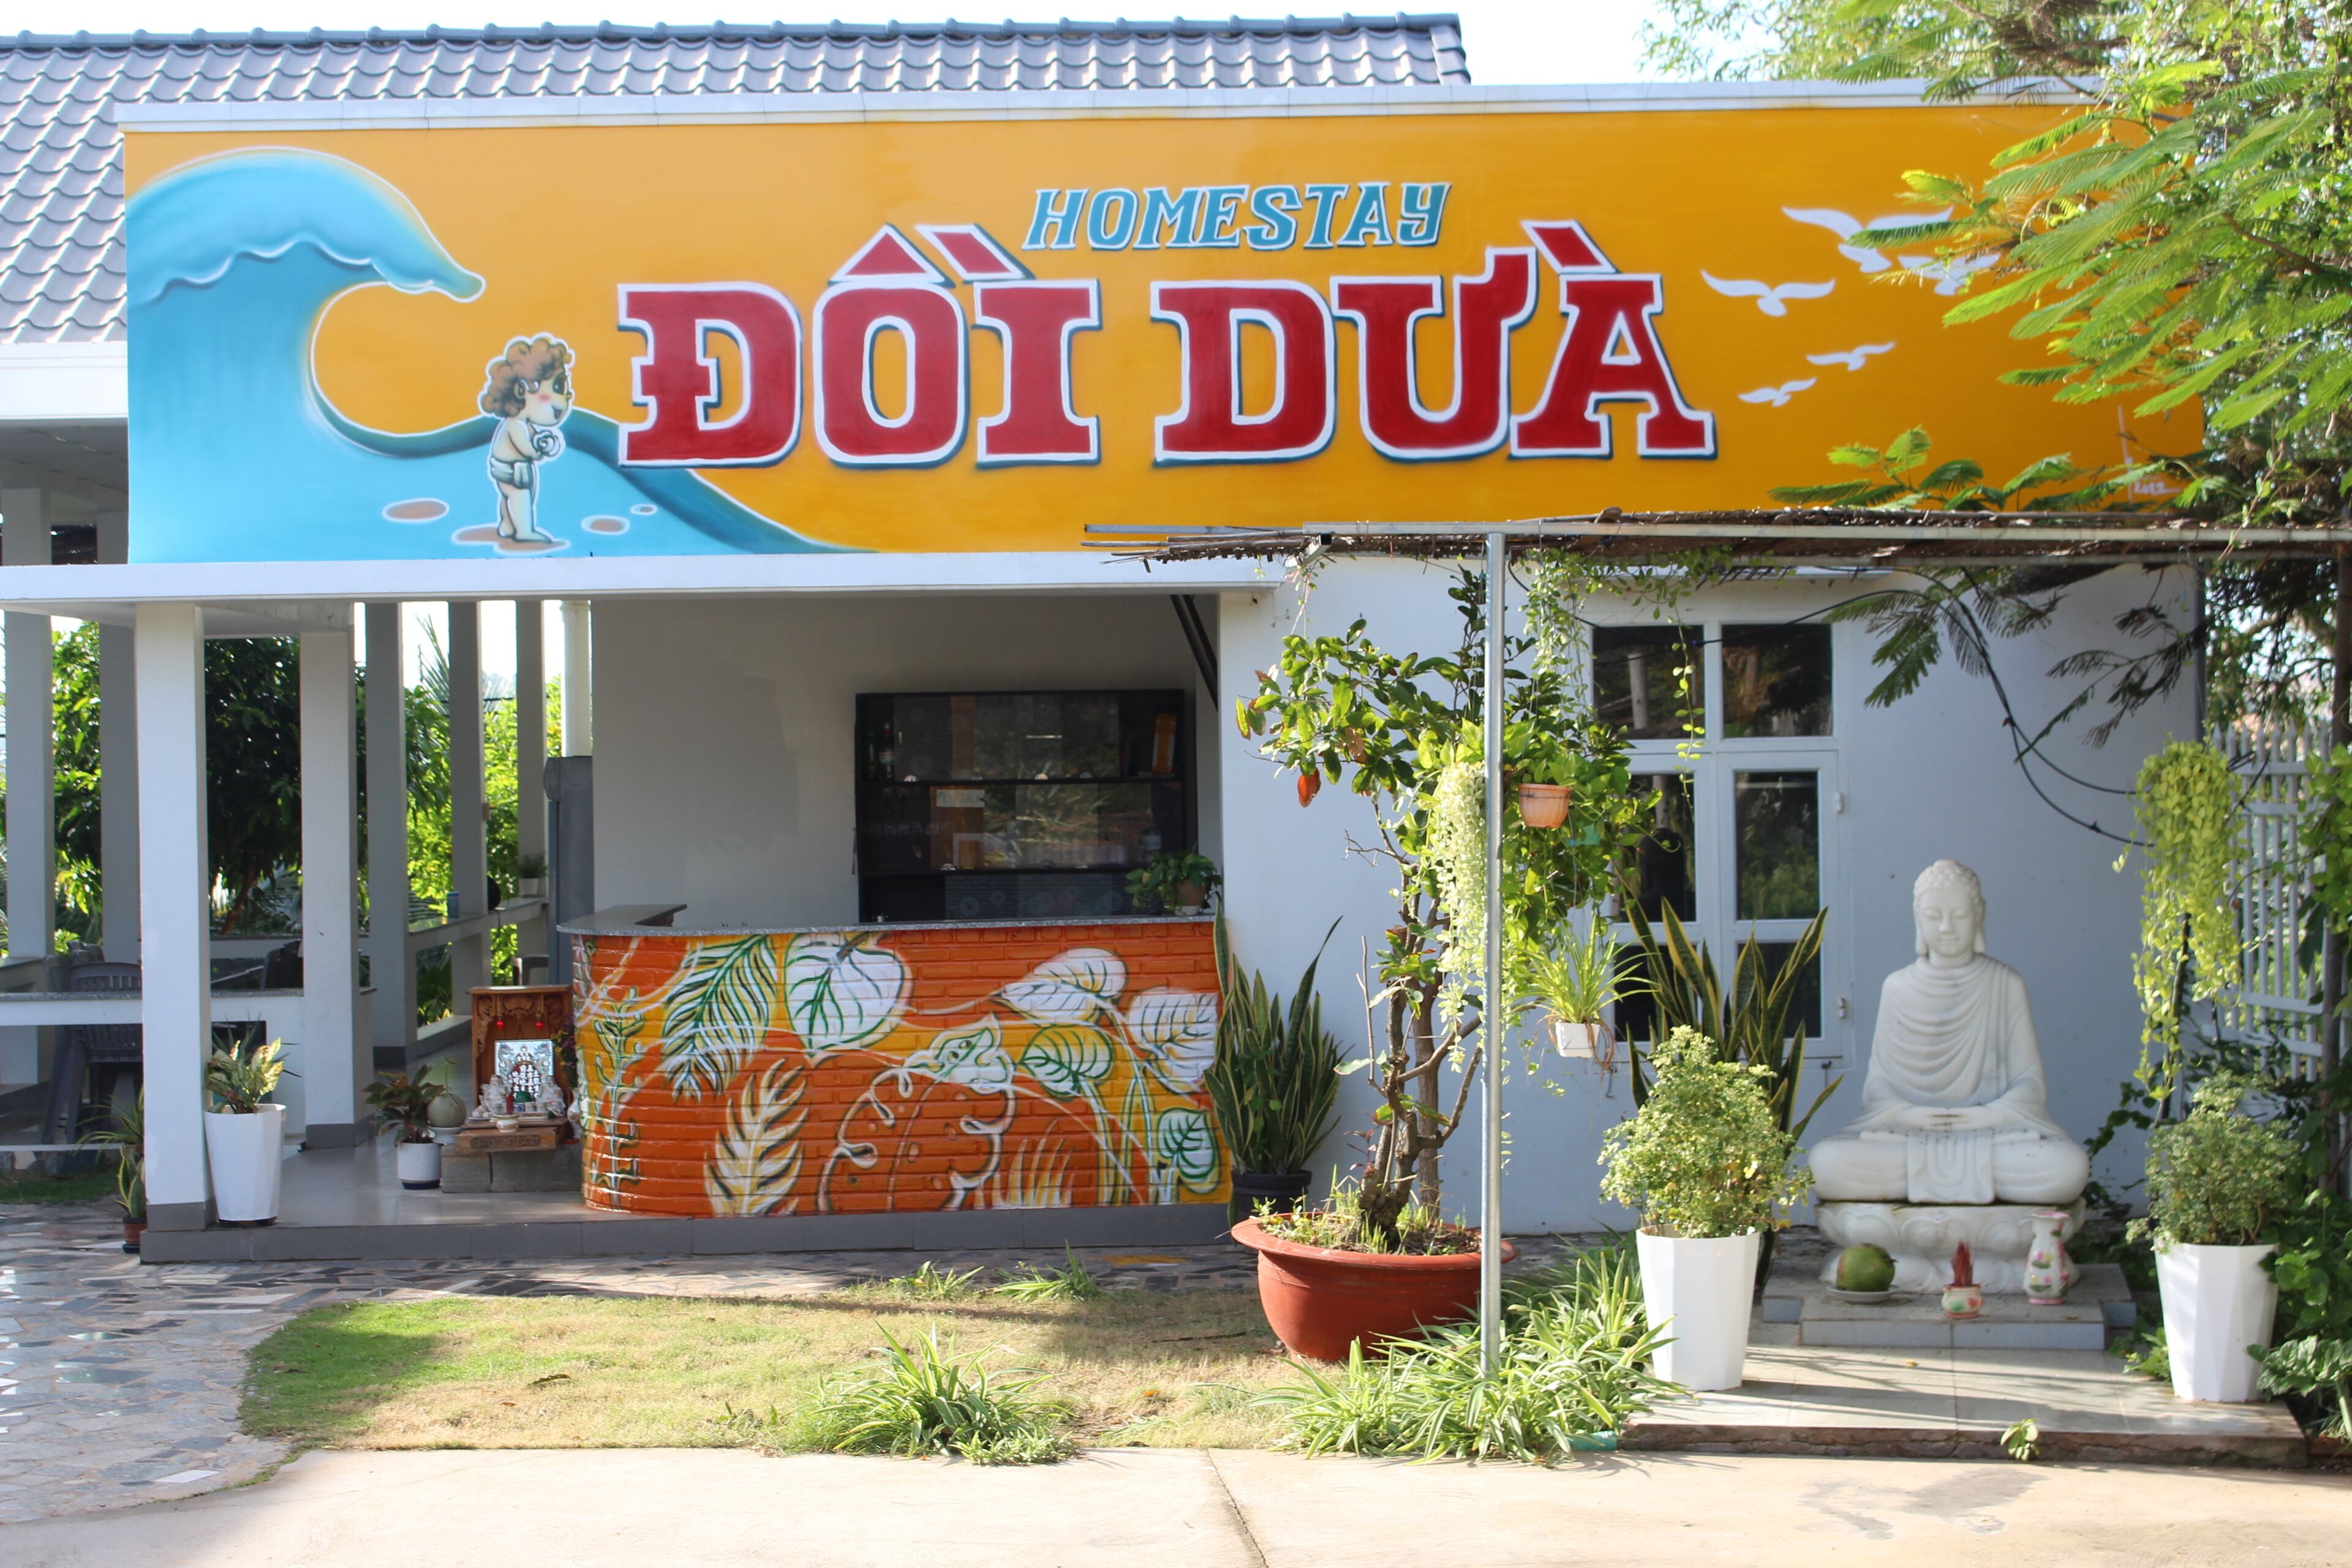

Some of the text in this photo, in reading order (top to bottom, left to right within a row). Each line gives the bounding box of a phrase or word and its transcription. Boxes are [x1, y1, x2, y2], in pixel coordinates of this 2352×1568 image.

[1020, 181, 1452, 251] HOMESTAY
[616, 219, 1718, 469] ĐỒI DỪA
